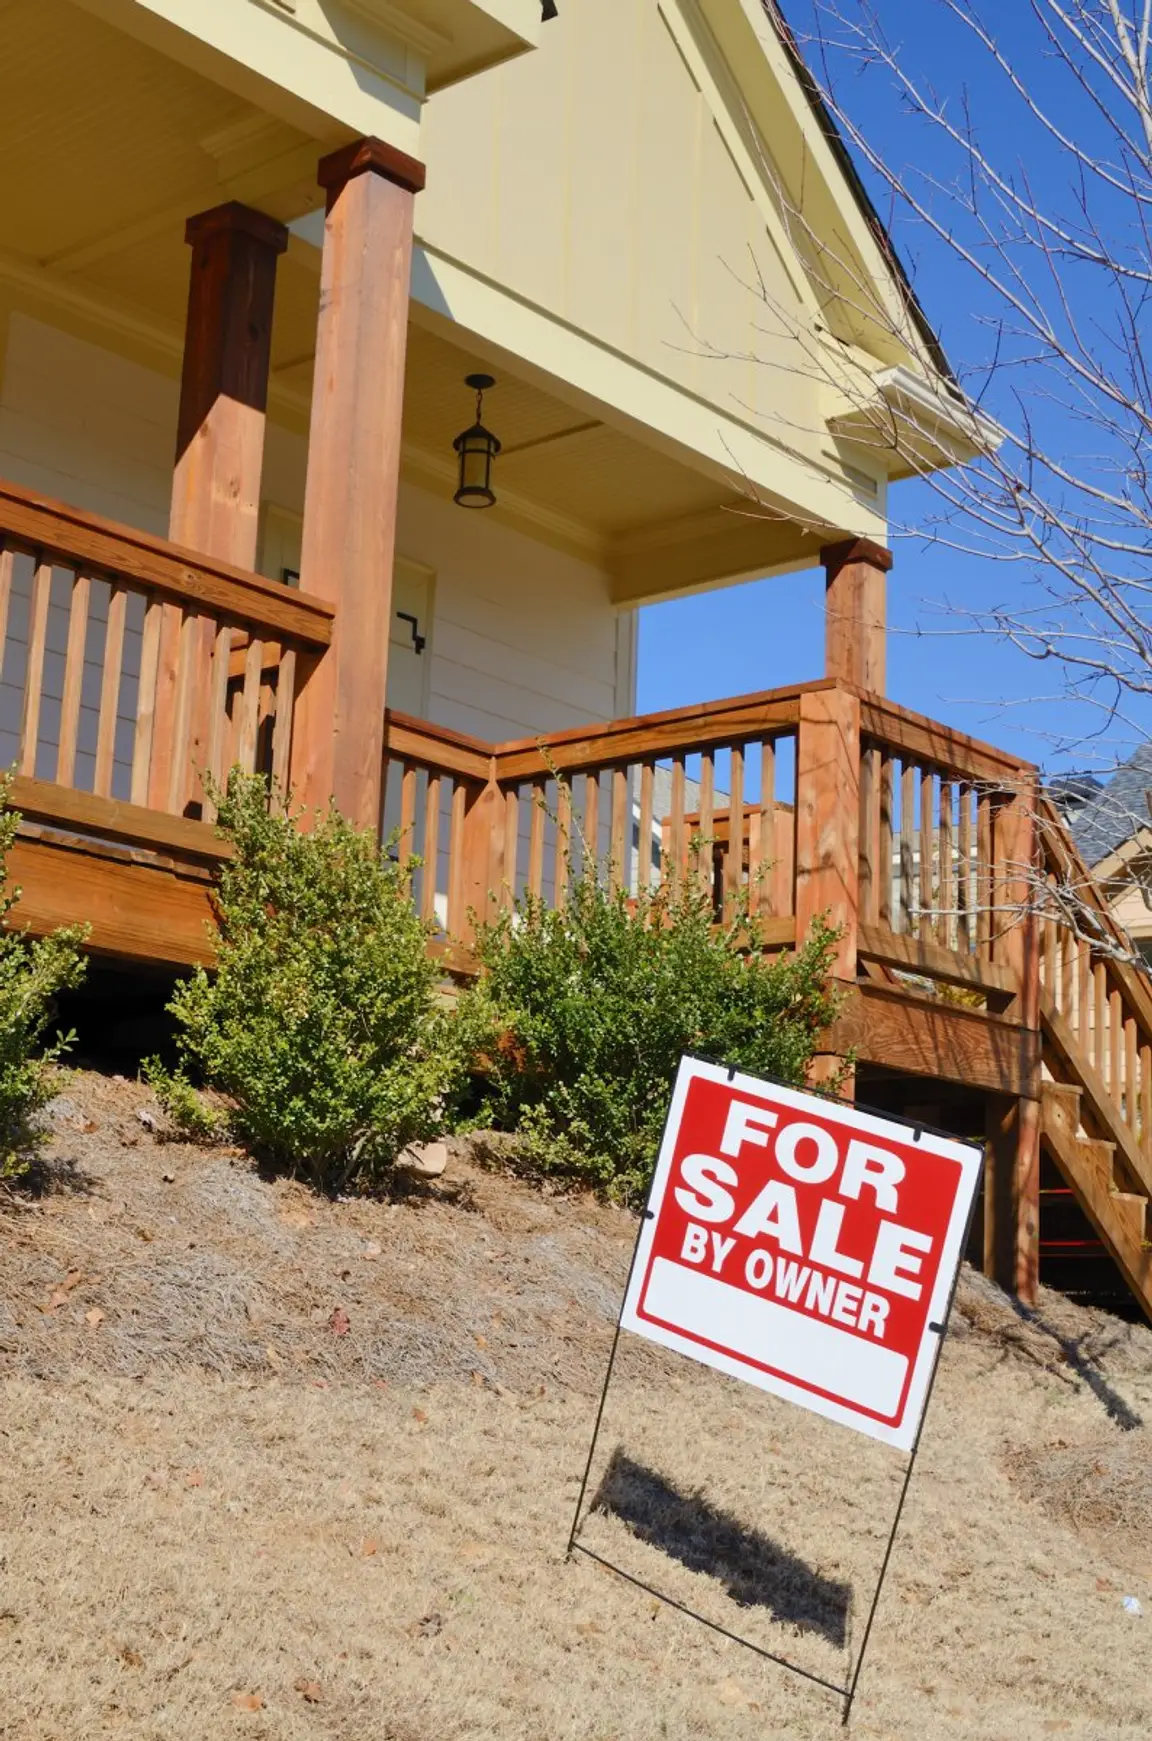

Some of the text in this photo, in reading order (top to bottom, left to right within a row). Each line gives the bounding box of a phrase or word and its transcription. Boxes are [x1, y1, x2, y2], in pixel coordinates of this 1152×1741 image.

[719, 1099, 906, 1214] FOR
[674, 1153, 934, 1302] SALE
[680, 1222, 891, 1339] BY OWNER
